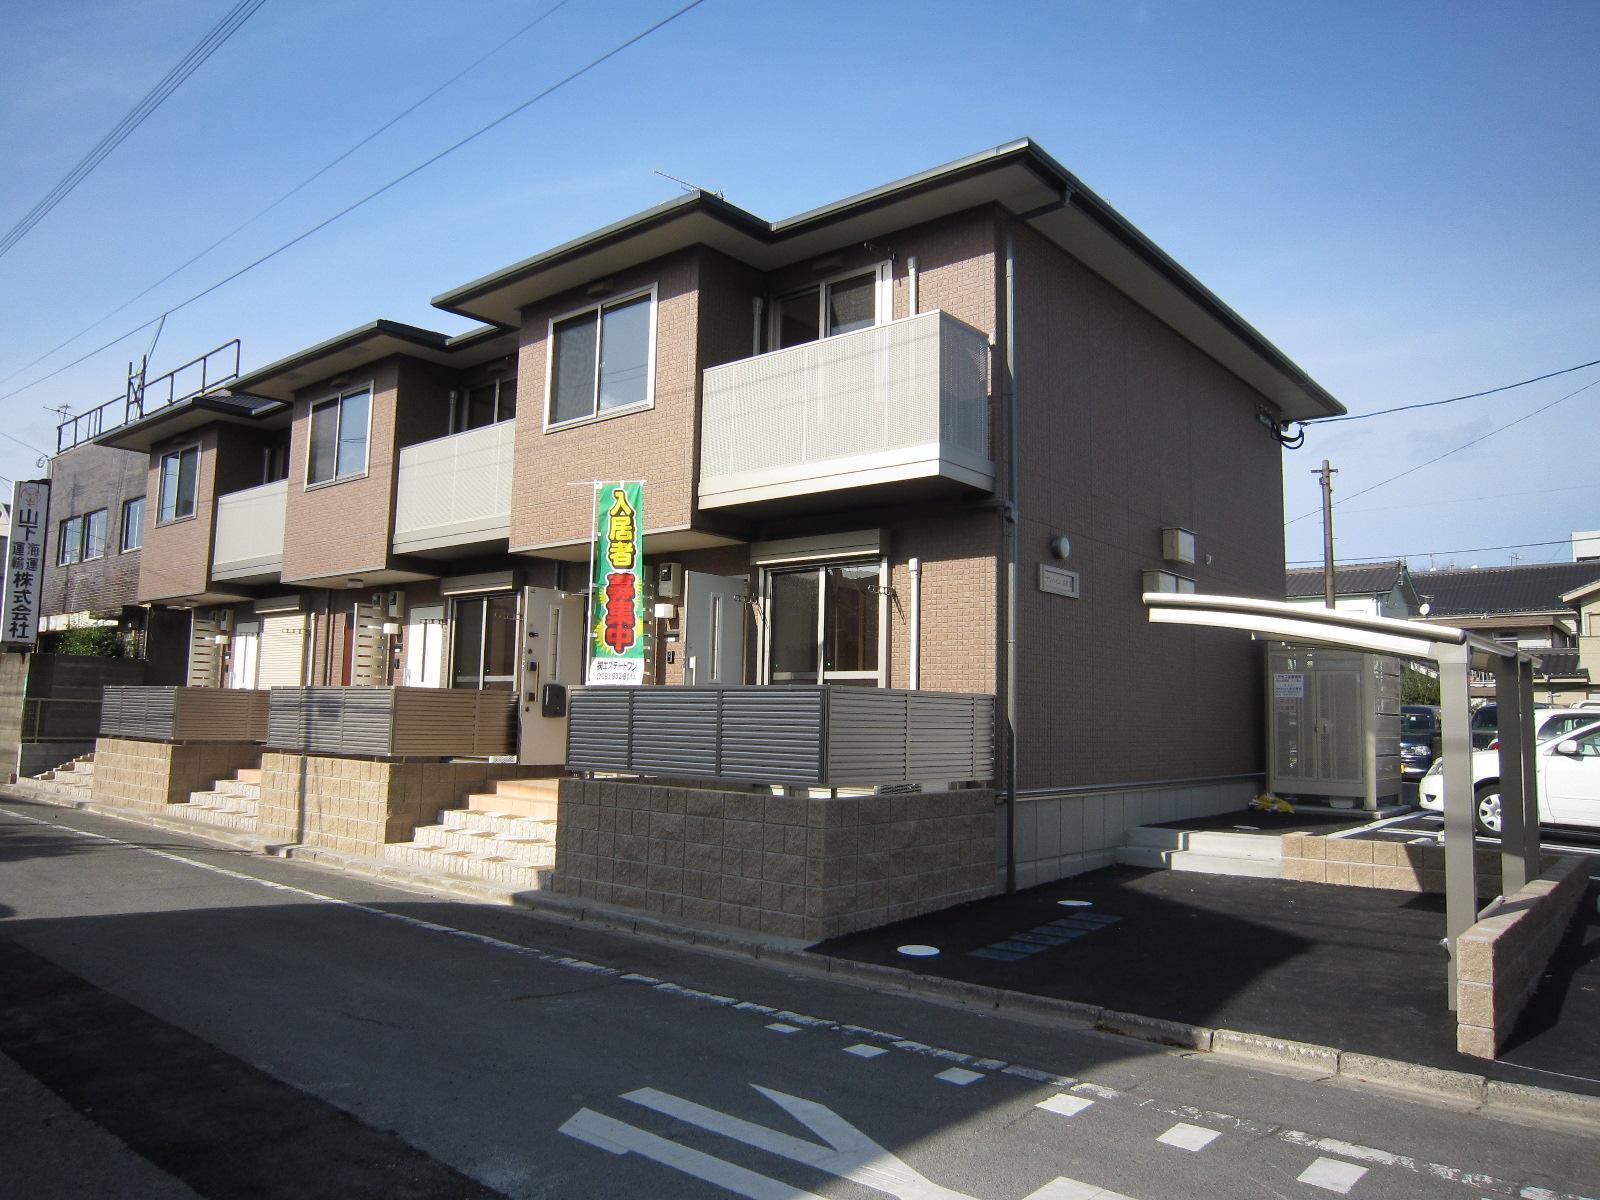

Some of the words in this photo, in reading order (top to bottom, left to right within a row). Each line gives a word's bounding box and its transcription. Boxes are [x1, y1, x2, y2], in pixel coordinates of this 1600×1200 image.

[18, 509, 39, 541] 山下
[8, 571, 33, 639] 株式会社
[607, 489, 636, 653] 入居者募集中
